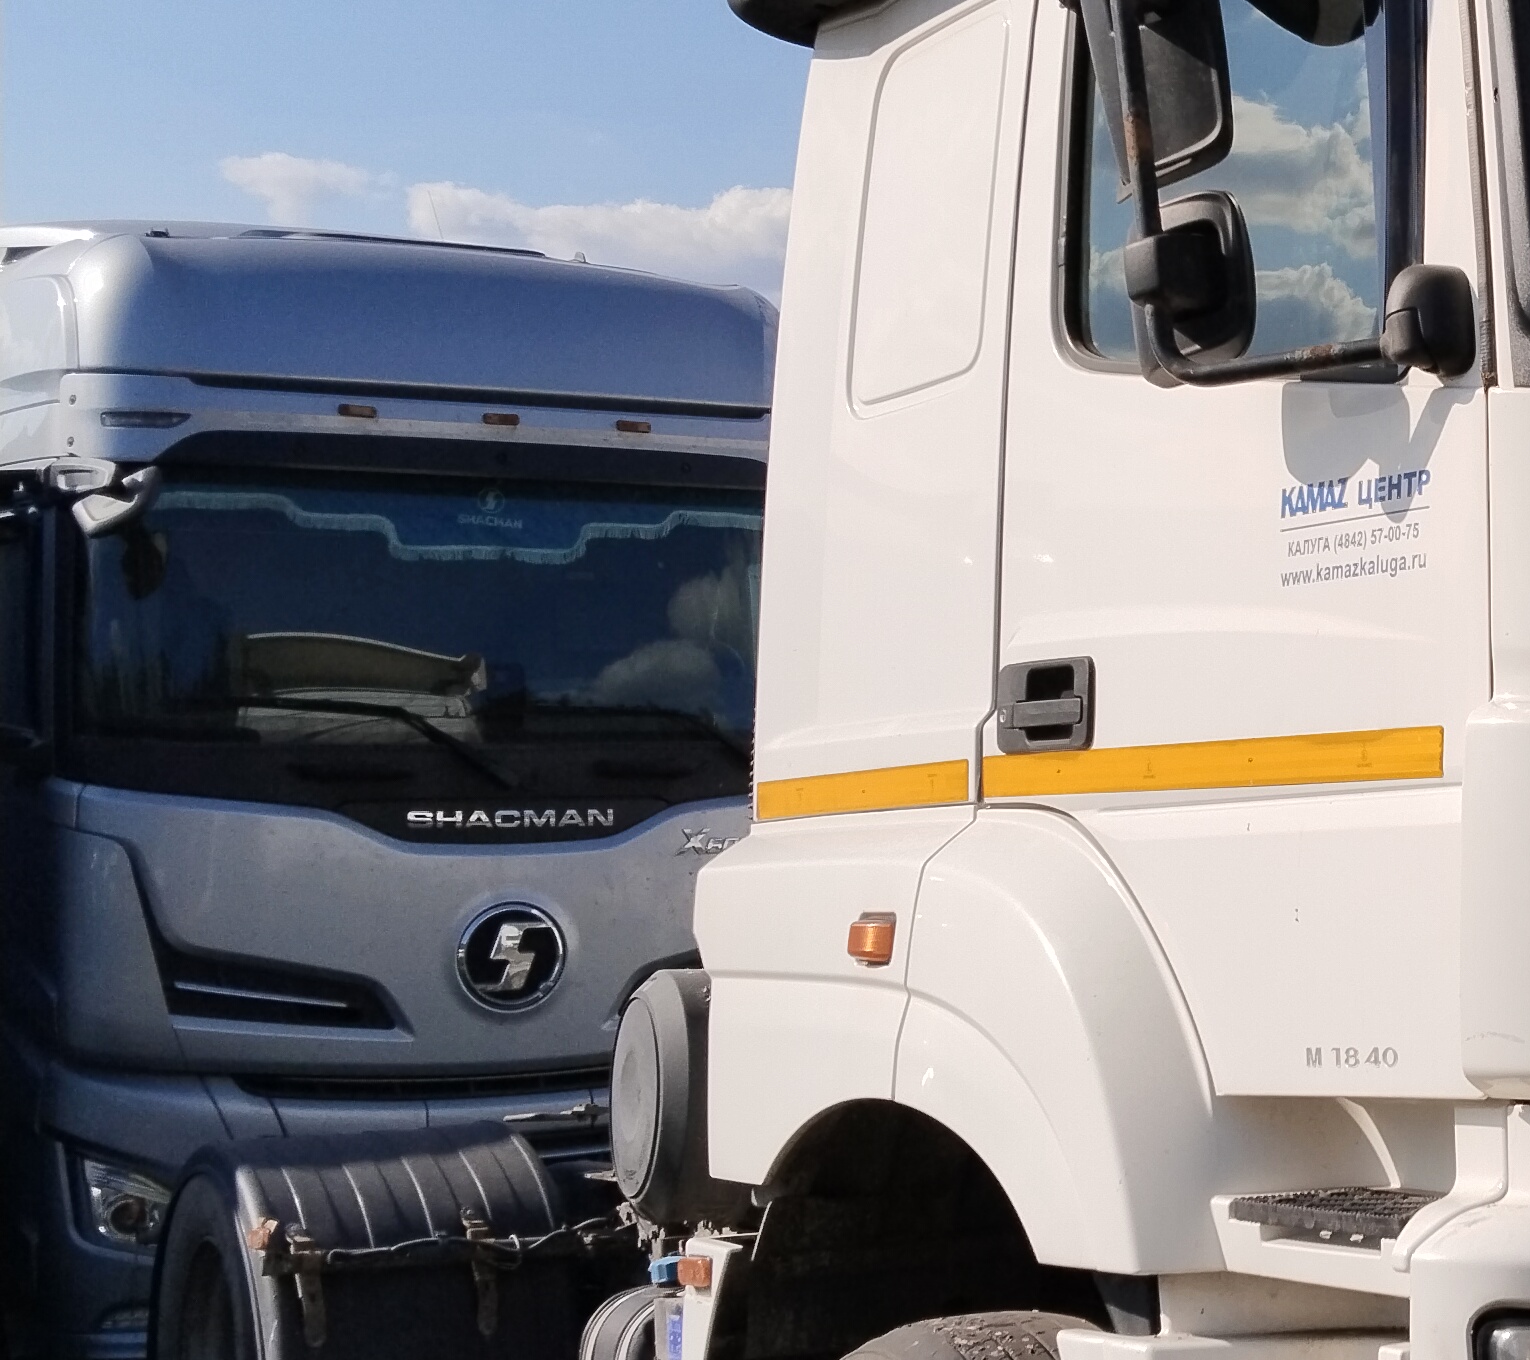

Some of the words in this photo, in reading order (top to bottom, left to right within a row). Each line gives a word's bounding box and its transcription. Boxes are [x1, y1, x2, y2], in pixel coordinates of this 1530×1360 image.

[1281, 477, 1348, 518] KAMAZ
[1358, 470, 1431, 509] ЦЕНТР
[1287, 537, 1330, 557] КАЛУГА
[1333, 530, 1367, 554] (4842)
[1370, 522, 1420, 545] 57-00-75
[1281, 553, 1427, 587] www.kamazkaluga.ru
[406, 809, 614, 828] SHACMAN
[1305, 1047, 1322, 1068] M
[1331, 1047, 1398, 1068] 1840
